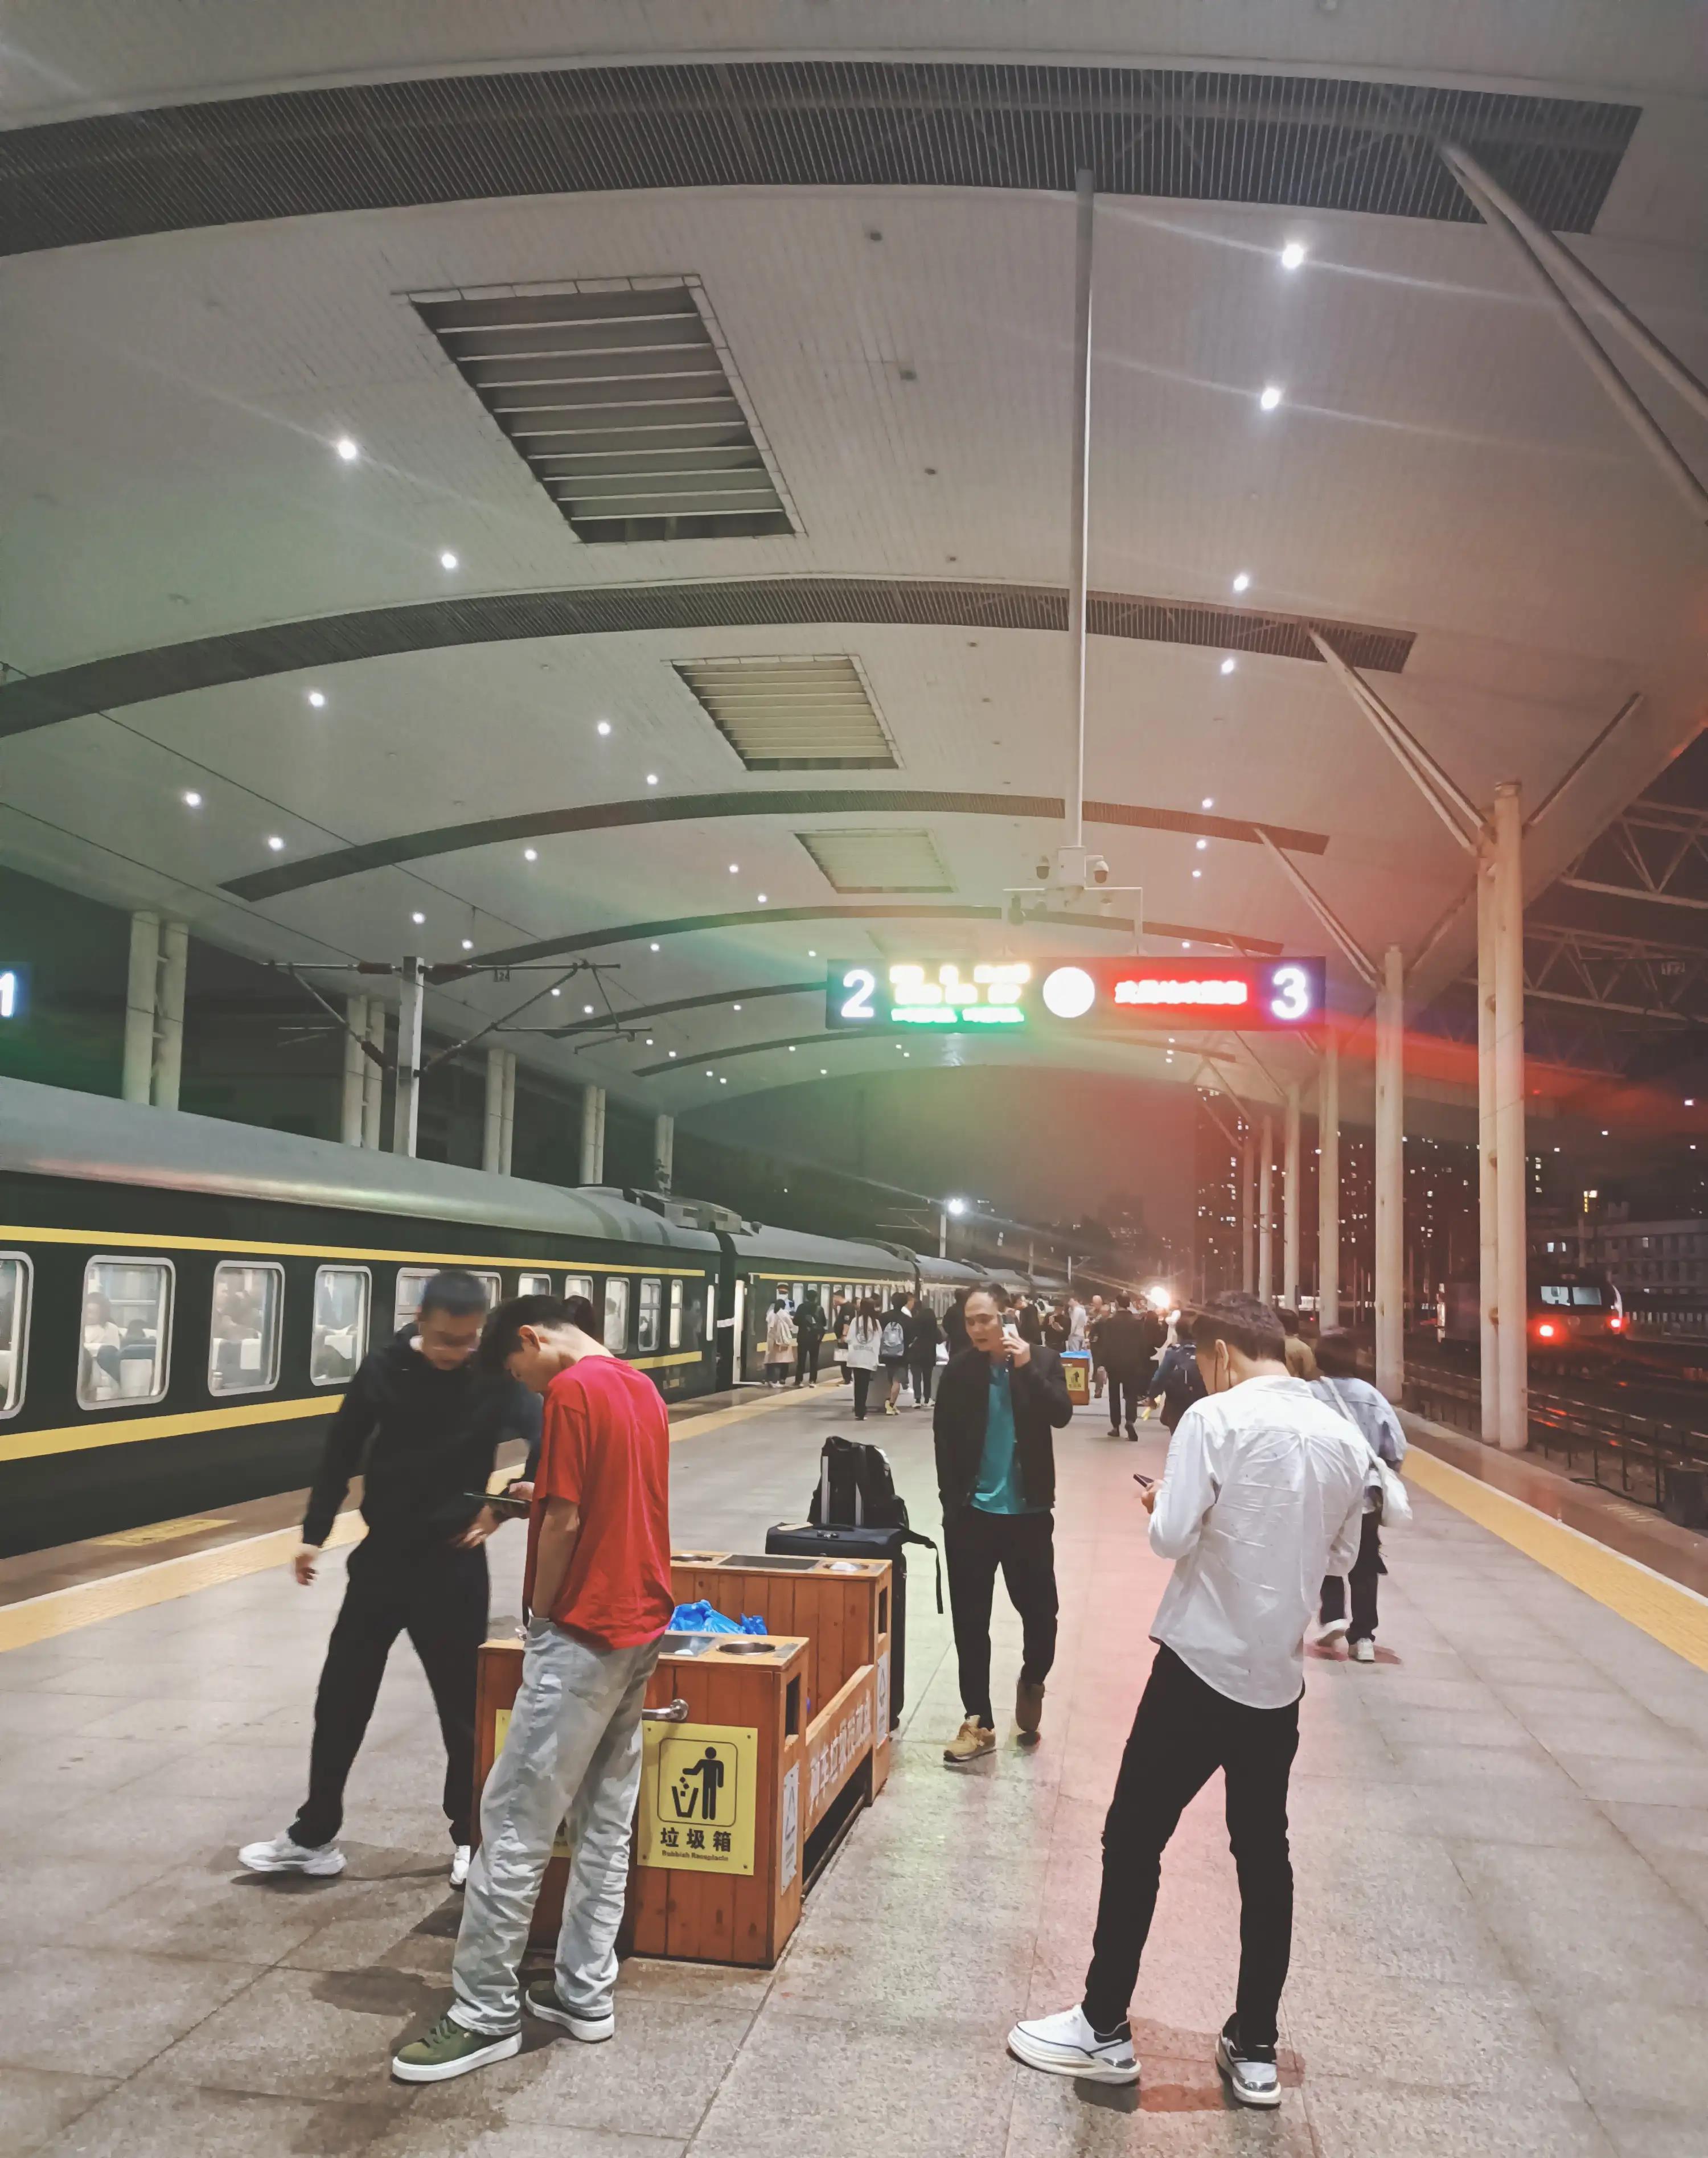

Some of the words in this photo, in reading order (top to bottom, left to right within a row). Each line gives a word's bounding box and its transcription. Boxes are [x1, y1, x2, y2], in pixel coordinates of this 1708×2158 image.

[0, 971, 15, 1016] 1
[841, 969, 876, 1018] 2
[1271, 967, 1309, 1020] 3
[660, 1827, 732, 1852] 垃圾箱
